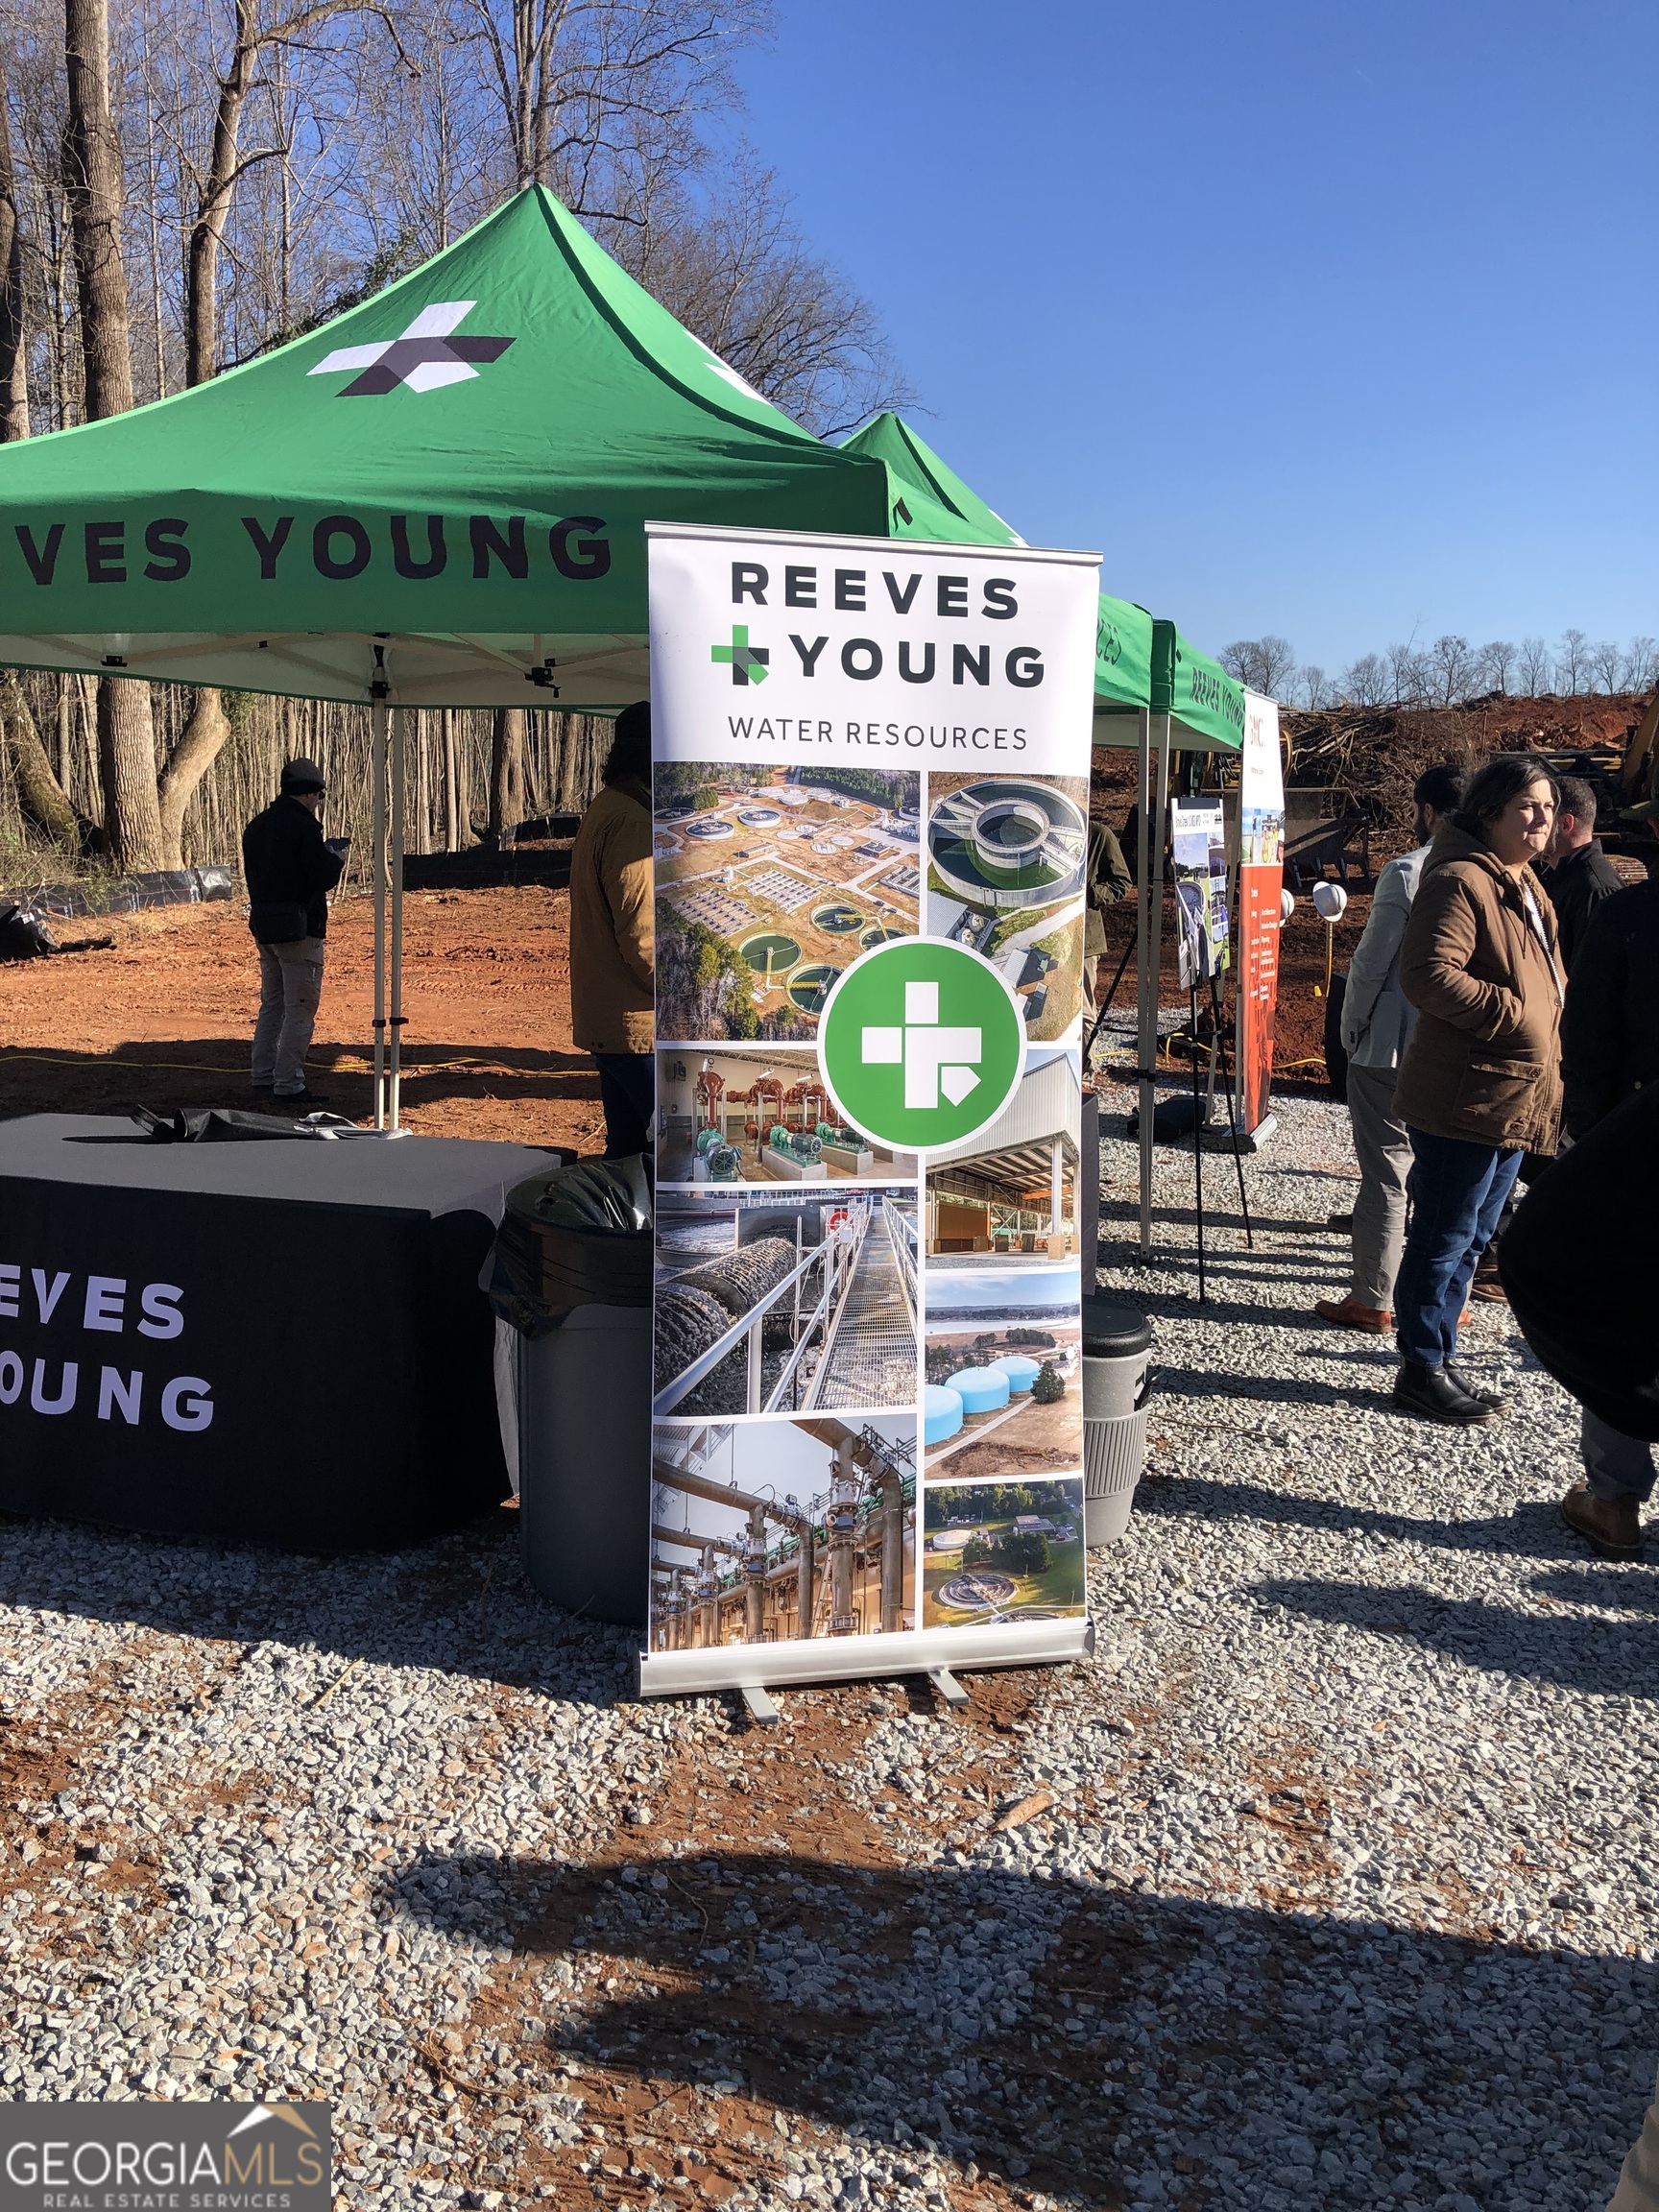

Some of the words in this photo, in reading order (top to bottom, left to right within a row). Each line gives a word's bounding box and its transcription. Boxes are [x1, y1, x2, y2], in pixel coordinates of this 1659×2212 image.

[14, 519, 192, 586] VES
[240, 515, 612, 580] YOUNG
[732, 562, 1019, 620] REEVES
[788, 634, 1045, 688] YOUNG
[1095, 618, 1121, 666] CES
[1189, 667, 1219, 712] REEVES
[728, 716, 832, 743] WATER
[847, 722, 1027, 751] RESOURCES
[0, 1263, 184, 1339] EVES
[0, 1350, 214, 1431] OUNG
